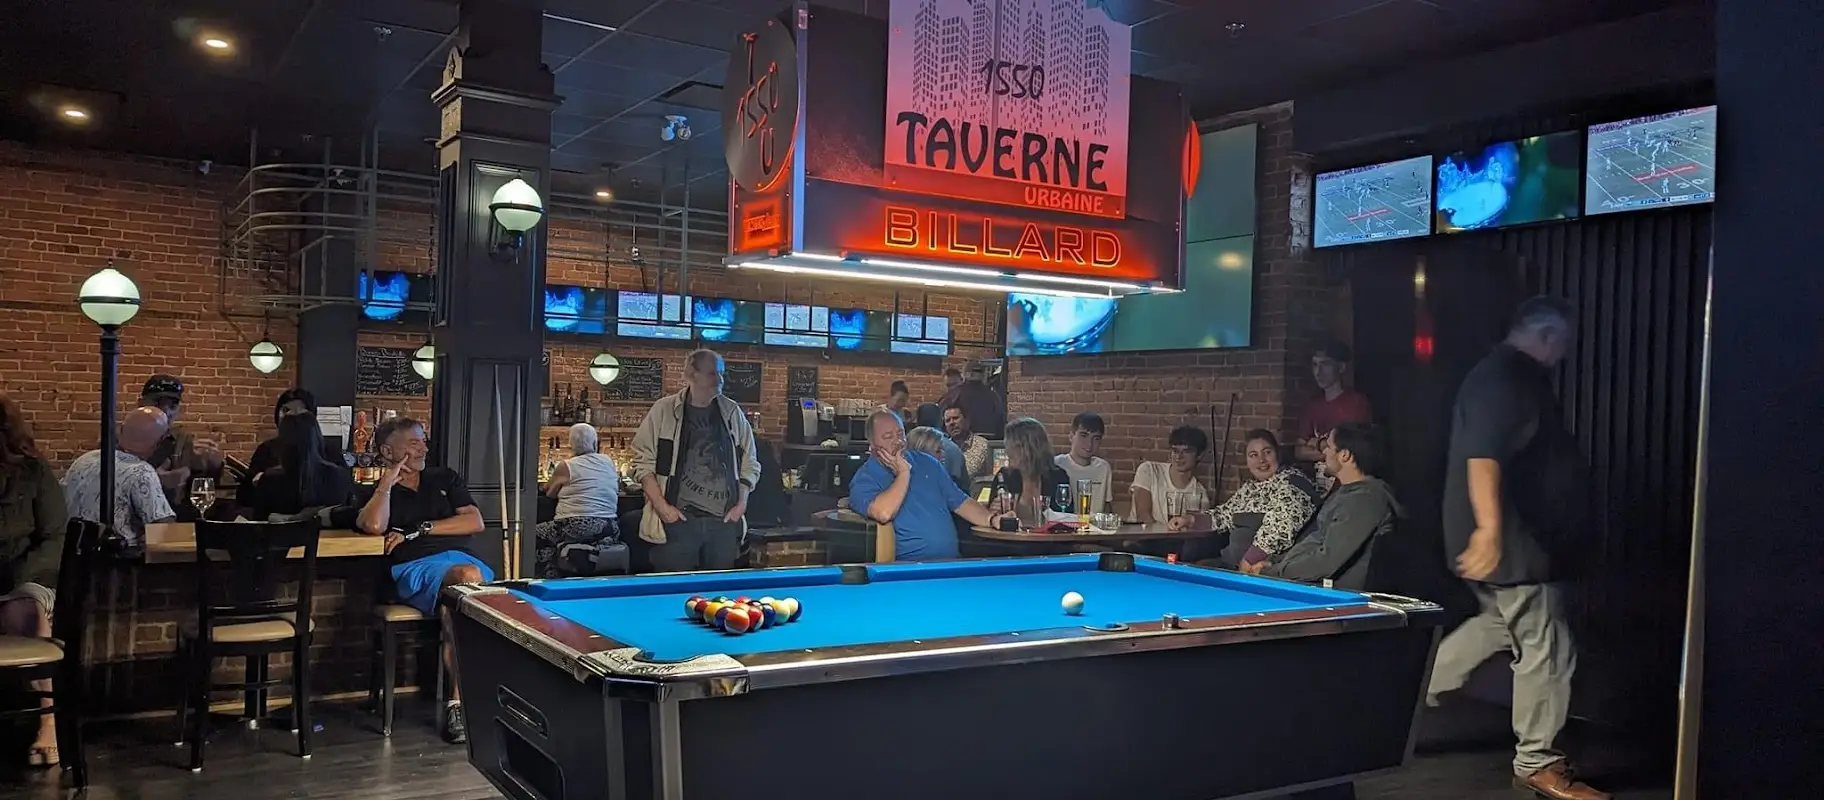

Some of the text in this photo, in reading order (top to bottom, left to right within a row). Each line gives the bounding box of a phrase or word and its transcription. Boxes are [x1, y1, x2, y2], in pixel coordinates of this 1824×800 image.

[736, 62, 779, 146] 1550
[980, 58, 1045, 100] 1550
[760, 127, 774, 176] U
[896, 111, 1109, 191] TAVERNE
[1024, 186, 1104, 213] URBAINE
[885, 206, 1121, 268] BILLARD
